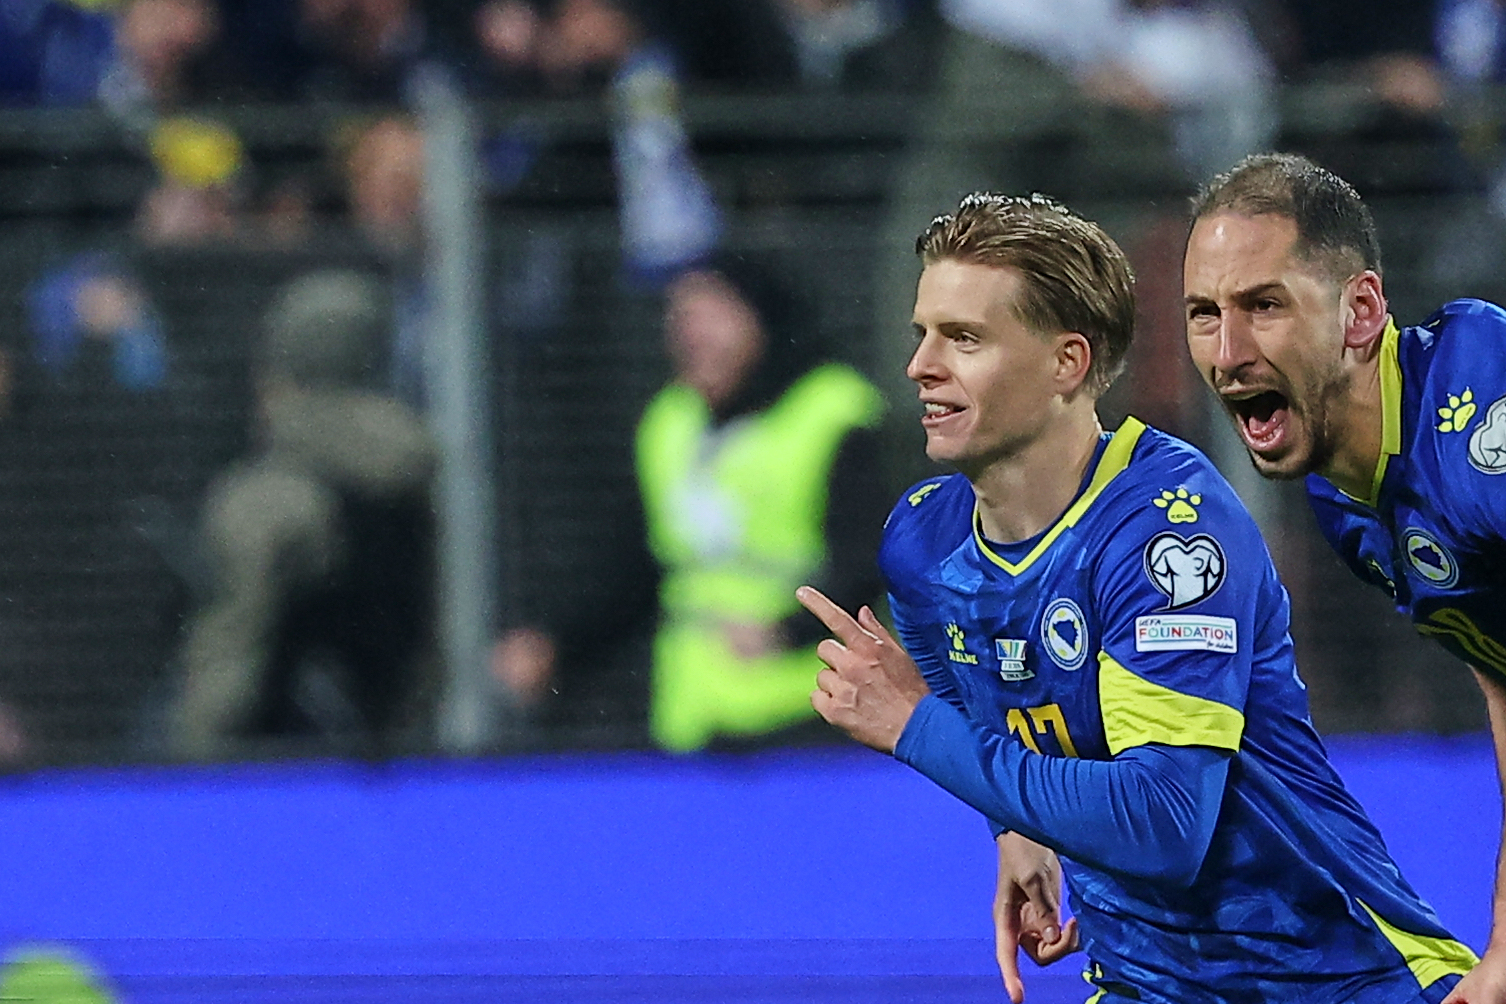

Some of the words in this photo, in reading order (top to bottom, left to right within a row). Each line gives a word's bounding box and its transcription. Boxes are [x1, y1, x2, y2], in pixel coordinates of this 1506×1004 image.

[1138, 618, 1162, 627] UEFA
[1138, 626, 1234, 642] FOUNDATION
[948, 649, 979, 665] KELME
[1005, 702, 1079, 759] 17
